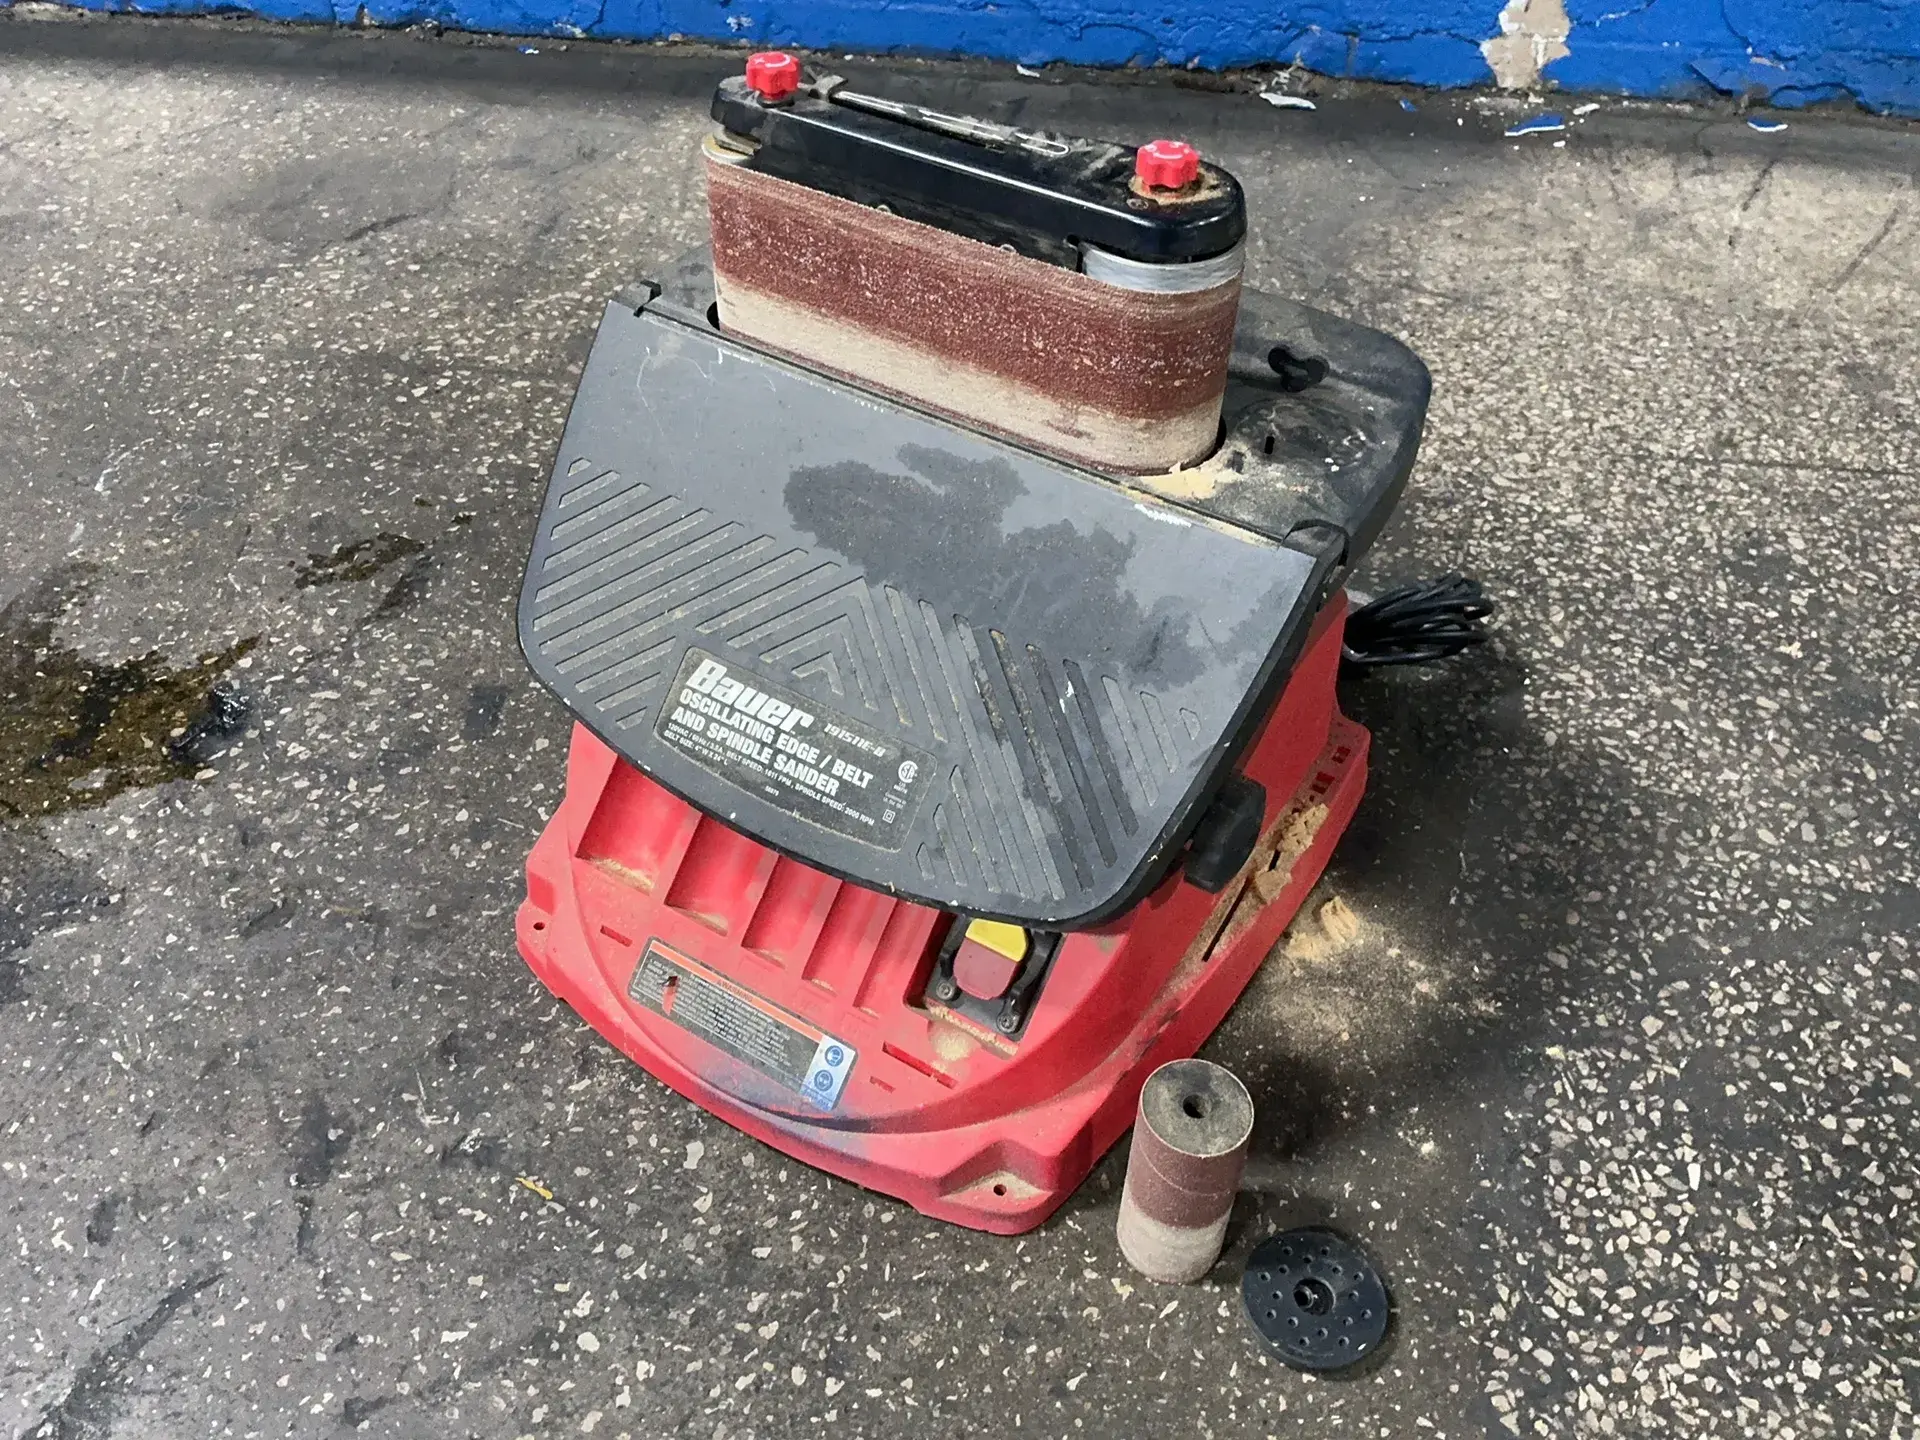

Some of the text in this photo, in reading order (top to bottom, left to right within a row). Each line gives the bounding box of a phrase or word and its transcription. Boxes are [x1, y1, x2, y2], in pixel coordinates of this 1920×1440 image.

[664, 730, 680, 741] BELT
[679, 737, 694, 748] SIZE:
[680, 688, 873, 788] OSCILLATING EDGE / BELT
[685, 658, 814, 732] Bauer
[668, 723, 689, 737] 120VAC
[726, 750, 742, 762] BELT
[742, 758, 765, 773] SPEED:
[795, 783, 822, 800] SPINDLE
[821, 796, 845, 812] SPEED:
[845, 807, 860, 819] 2000
[859, 814, 875, 826] RPM
[671, 706, 839, 796] AND SPINDLE SANDER
